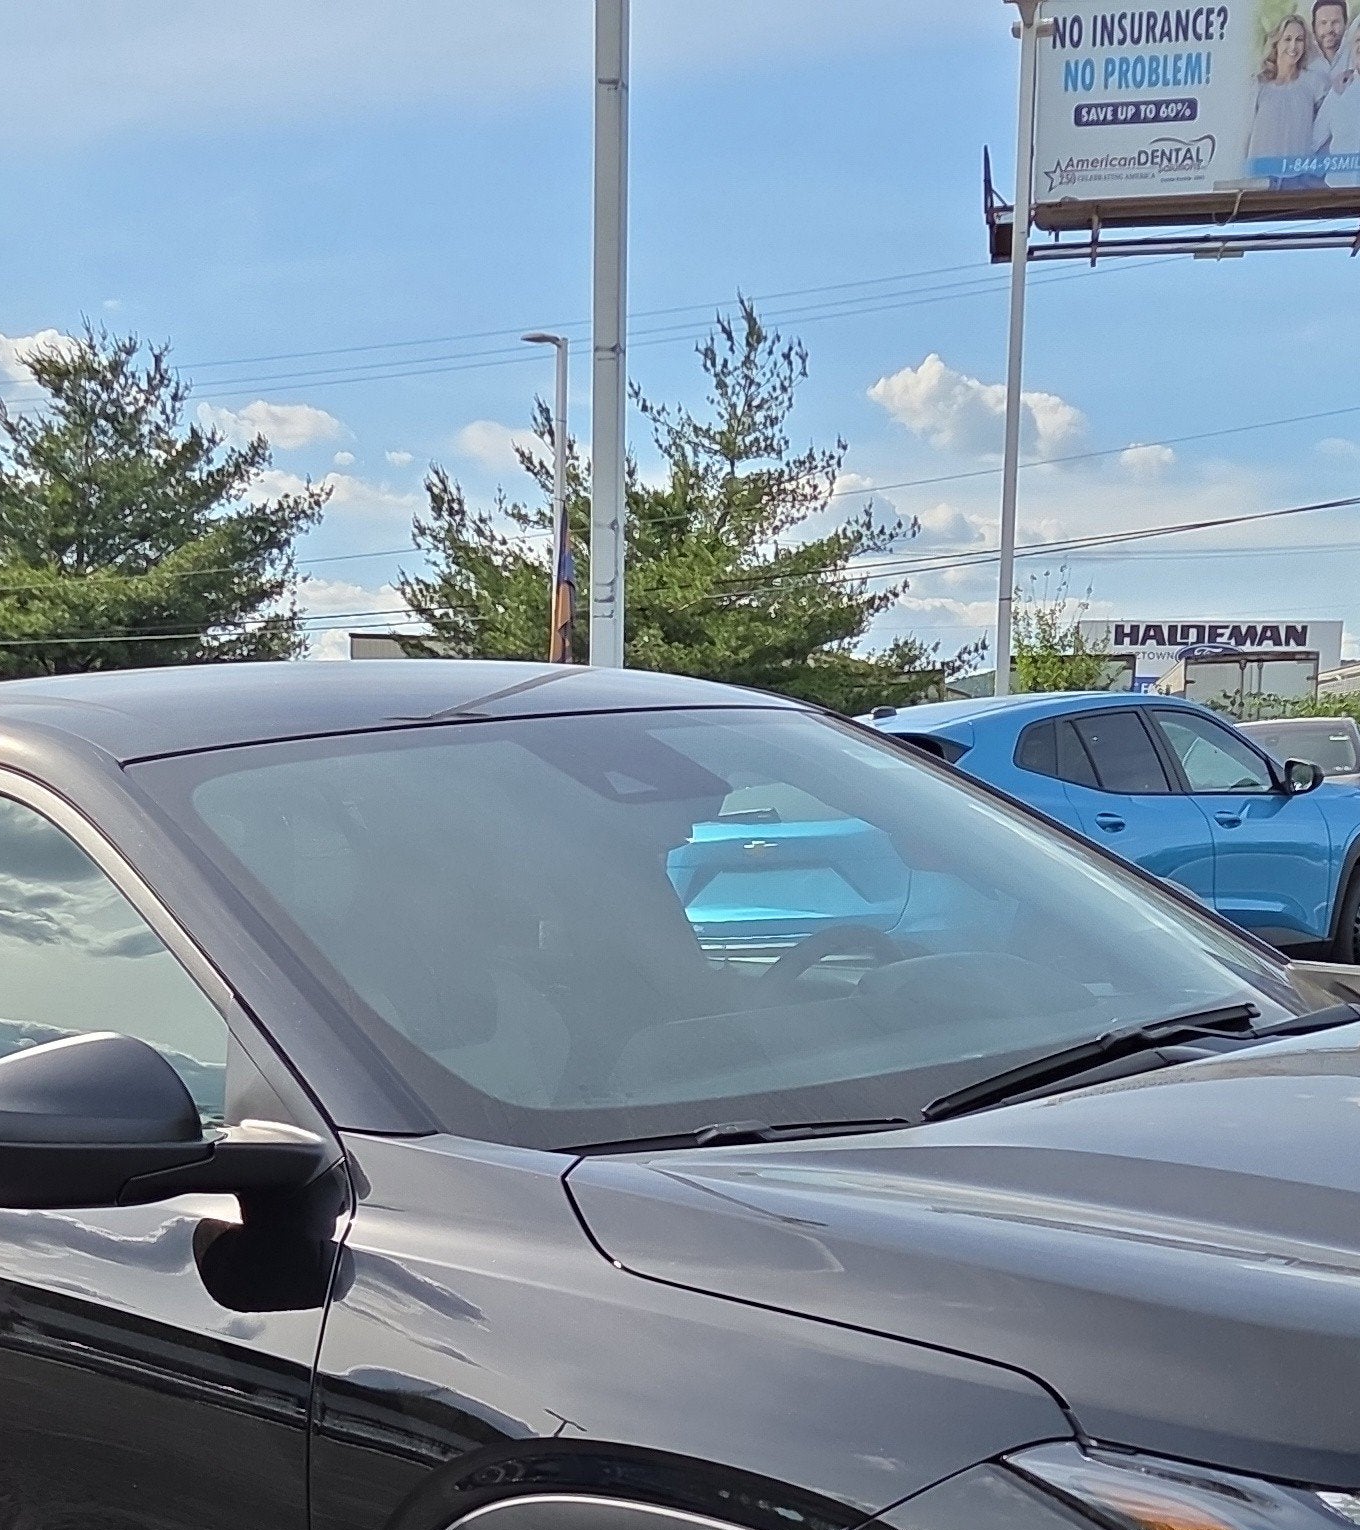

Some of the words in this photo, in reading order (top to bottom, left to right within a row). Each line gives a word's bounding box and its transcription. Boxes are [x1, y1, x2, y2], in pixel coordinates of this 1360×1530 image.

[1052, 15, 1083, 49] NO
[1091, 5, 1228, 47] INSURANCE?
[1064, 58, 1095, 92] NO
[1103, 51, 1212, 90] PROBLEM!
[1081, 107, 1113, 122] SAVE
[1117, 105, 1136, 120] UP
[1140, 104, 1156, 119] TO
[1159, 102, 1191, 117] 60%
[1114, 624, 1309, 647] HALDEMAN
